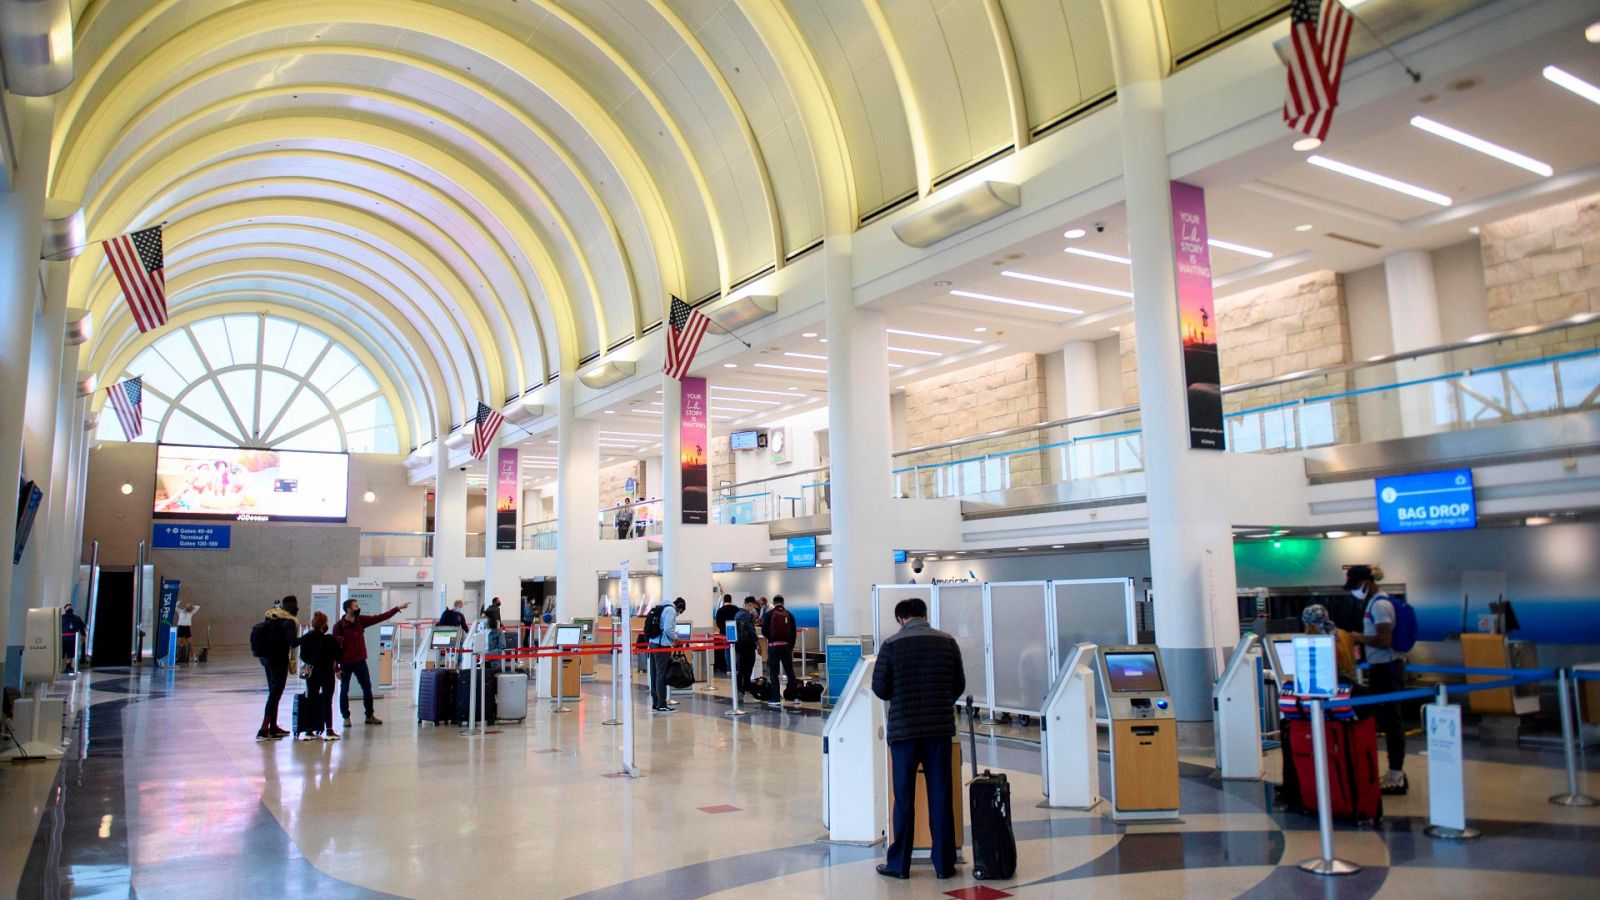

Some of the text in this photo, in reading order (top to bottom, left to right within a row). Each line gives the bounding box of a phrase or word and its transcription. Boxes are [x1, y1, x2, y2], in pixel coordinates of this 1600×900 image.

[1180, 212, 1200, 224] YOUR
[1181, 242, 1203, 255] STORY
[1190, 254, 1197, 264] IS
[1178, 261, 1210, 278] WAITING
[683, 421, 706, 429] WAITING
[1398, 503, 1470, 520] BAG DROP
[931, 577, 969, 585] American
[163, 593, 172, 606] TSA
